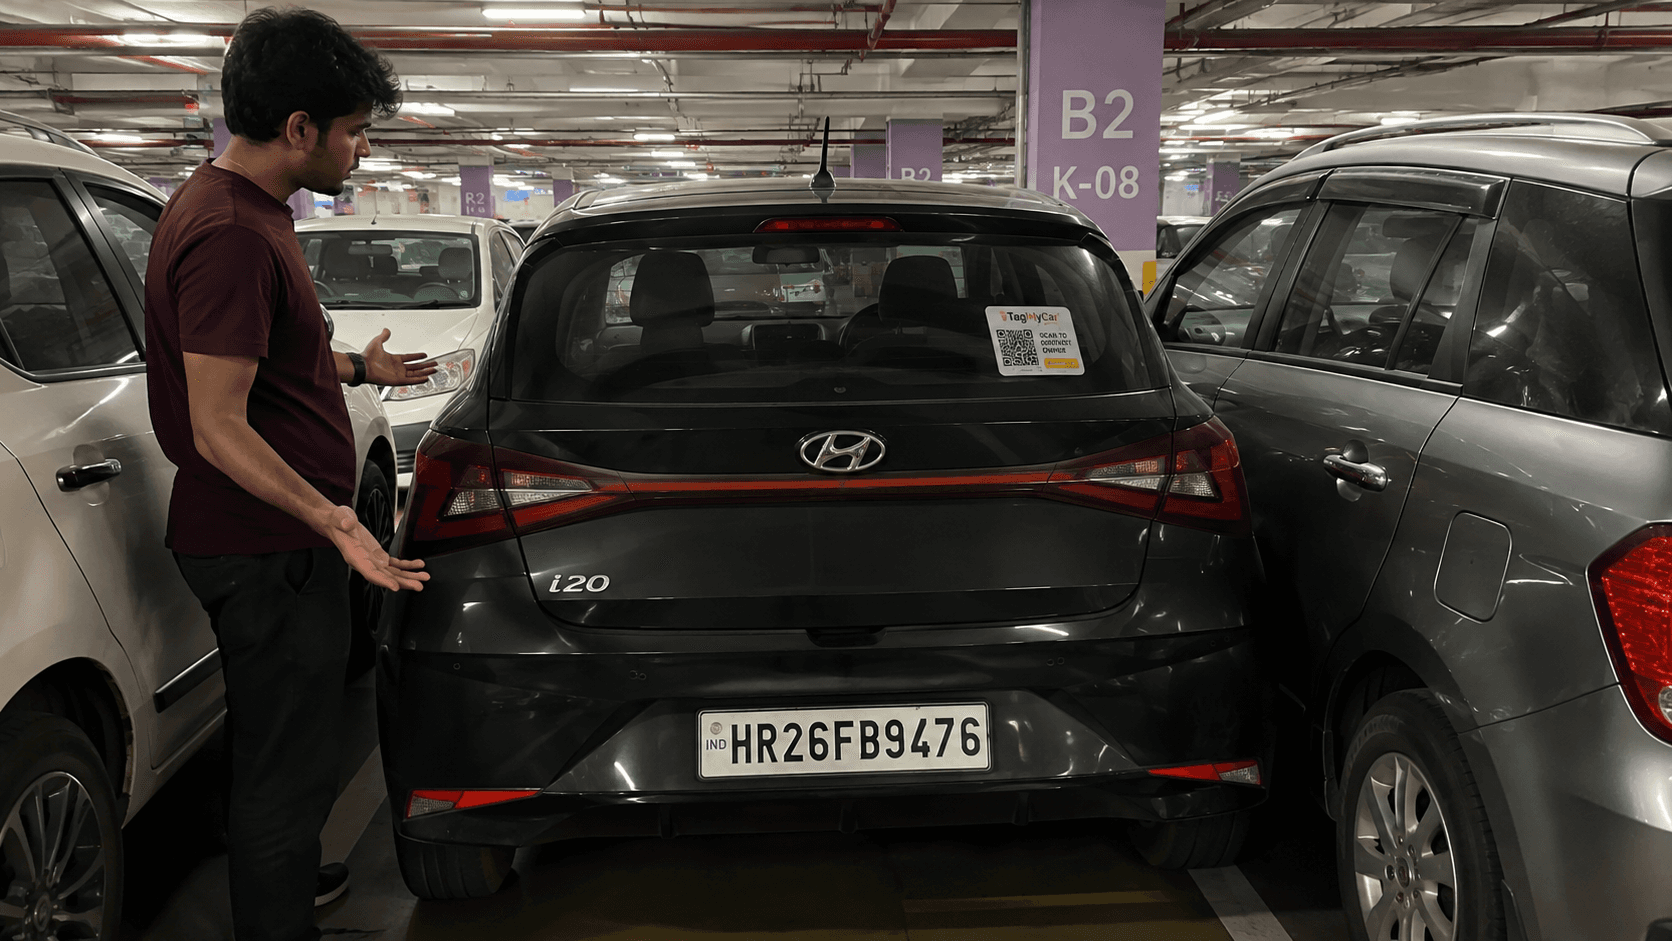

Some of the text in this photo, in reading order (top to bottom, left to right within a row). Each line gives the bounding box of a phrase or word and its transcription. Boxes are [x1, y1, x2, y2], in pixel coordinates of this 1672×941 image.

[1062, 89, 1134, 139] B2
[1053, 165, 1139, 199] K-08
[549, 574, 610, 593] i20
[706, 717, 981, 764] IND HR26FB9476
